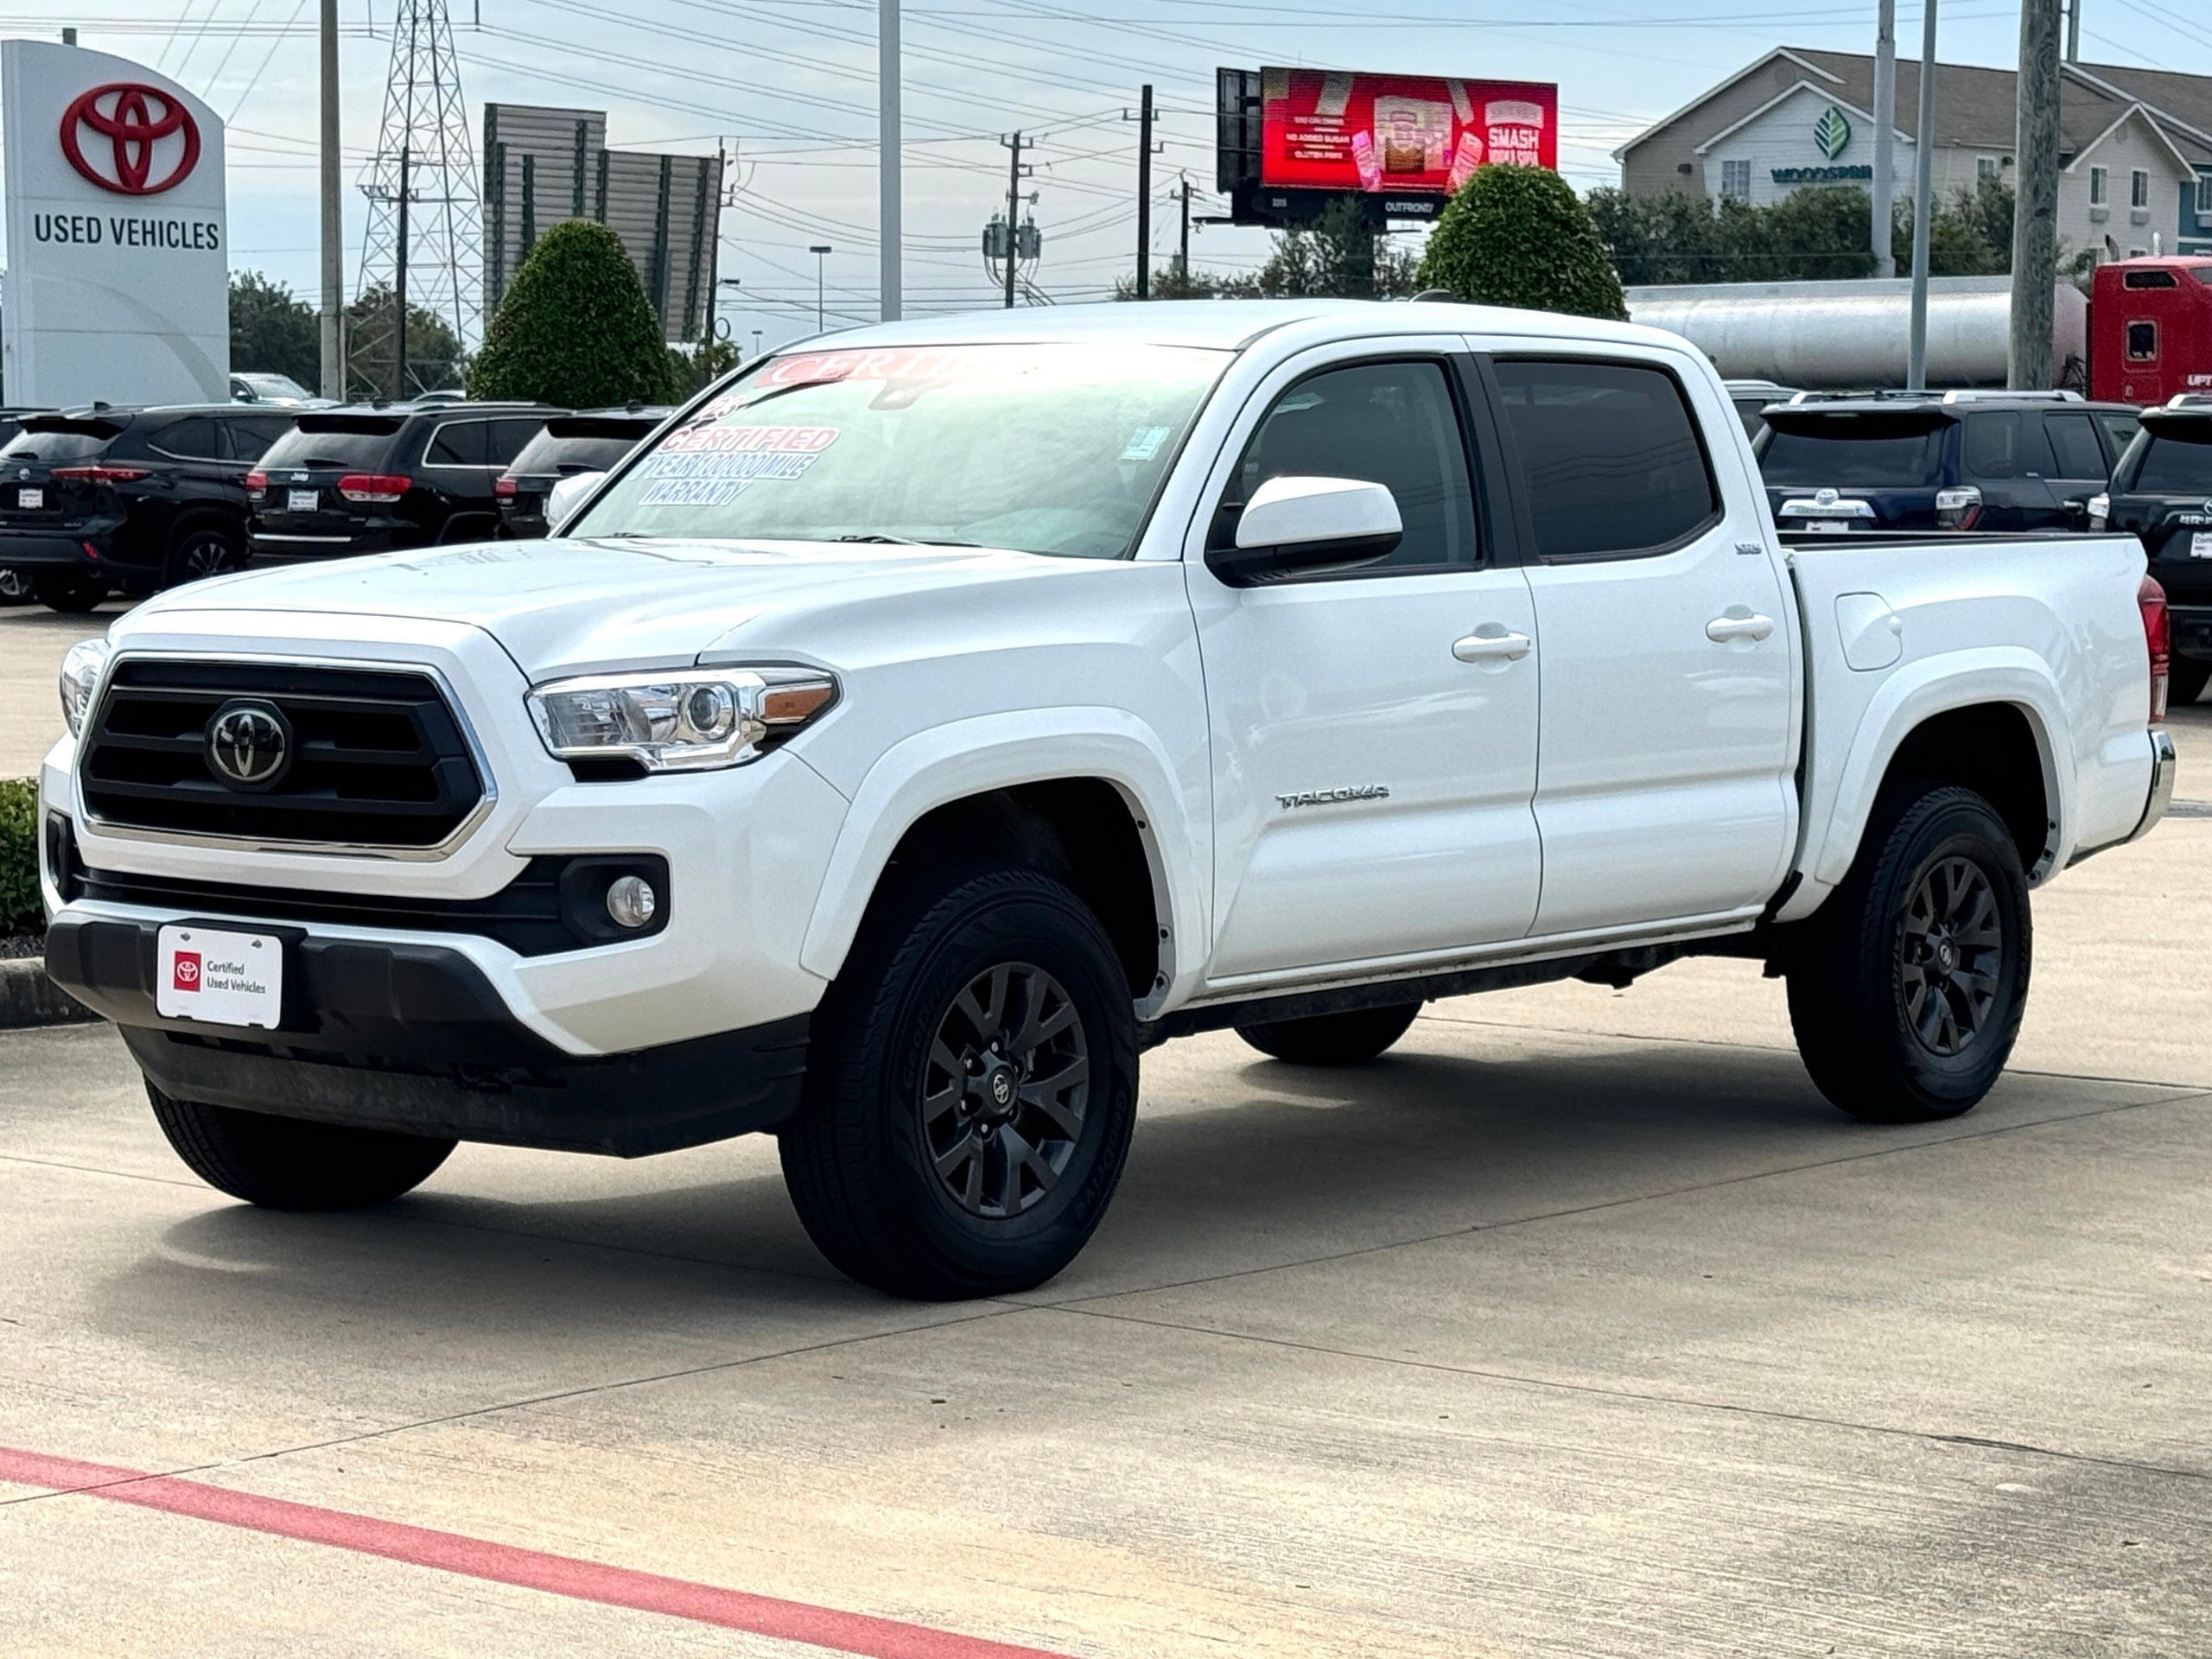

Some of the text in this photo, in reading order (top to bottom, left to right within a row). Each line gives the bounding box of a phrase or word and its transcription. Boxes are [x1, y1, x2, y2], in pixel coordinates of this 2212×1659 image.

[1488, 127, 1540, 150] SMASH
[35, 214, 219, 251] USED VEHICLES
[661, 428, 836, 451] CERTIFIED
[640, 479, 751, 504] WARRANTY
[1275, 785, 1389, 809] TACOMA
[207, 960, 245, 976] Certified
[207, 976, 266, 994] Used Vehicles
